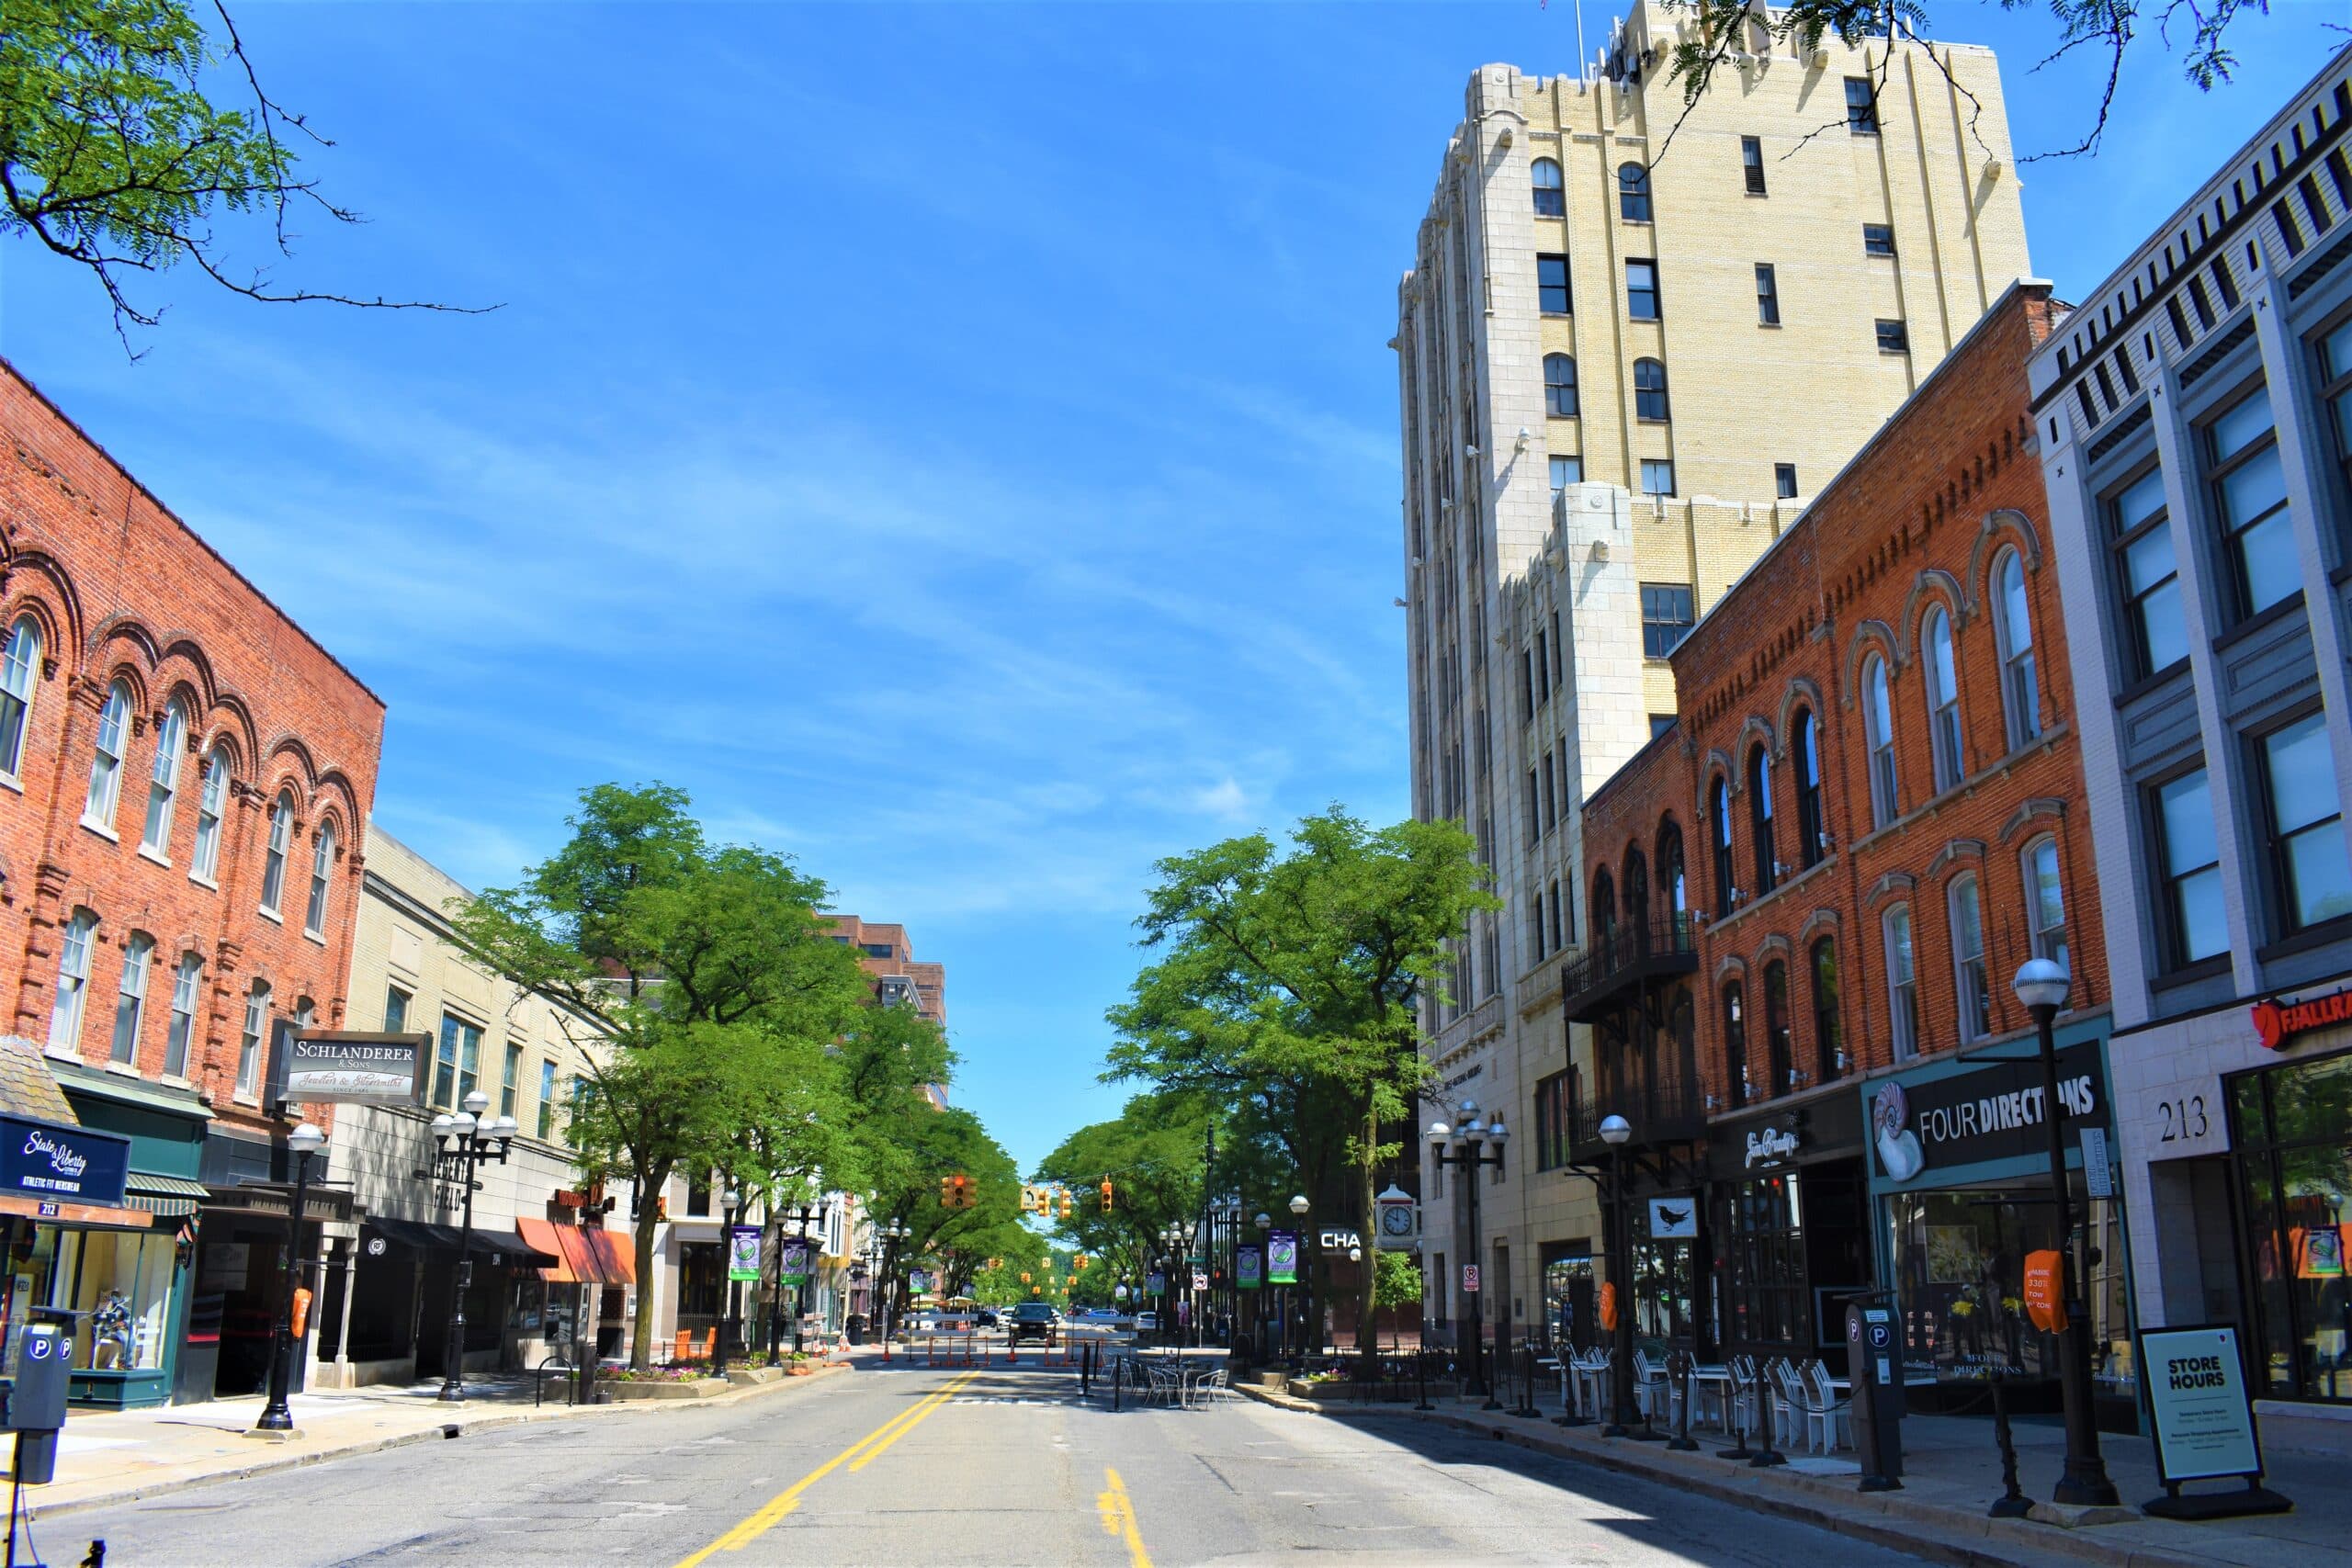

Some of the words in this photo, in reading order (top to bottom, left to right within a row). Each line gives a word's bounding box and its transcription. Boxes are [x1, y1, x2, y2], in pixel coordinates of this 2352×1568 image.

[296, 1041, 414, 1061] SCHLANDERER
[338, 1059, 345, 1068] &
[347, 1059, 370, 1069] SONS
[1919, 1102, 1978, 1145] FOUR
[1979, 1075, 2094, 1134] DIRECTNS
[2158, 1095, 2207, 1143] 213
[24, 1131, 54, 1155] State
[51, 1145, 87, 1177] Liberty
[430, 1152, 469, 1183] REGENT
[42, 1203, 56, 1215] 212
[434, 1185, 461, 1212] FIELD
[2168, 1356, 2222, 1374] STORE
[2170, 1372, 2225, 1391] HOURS
